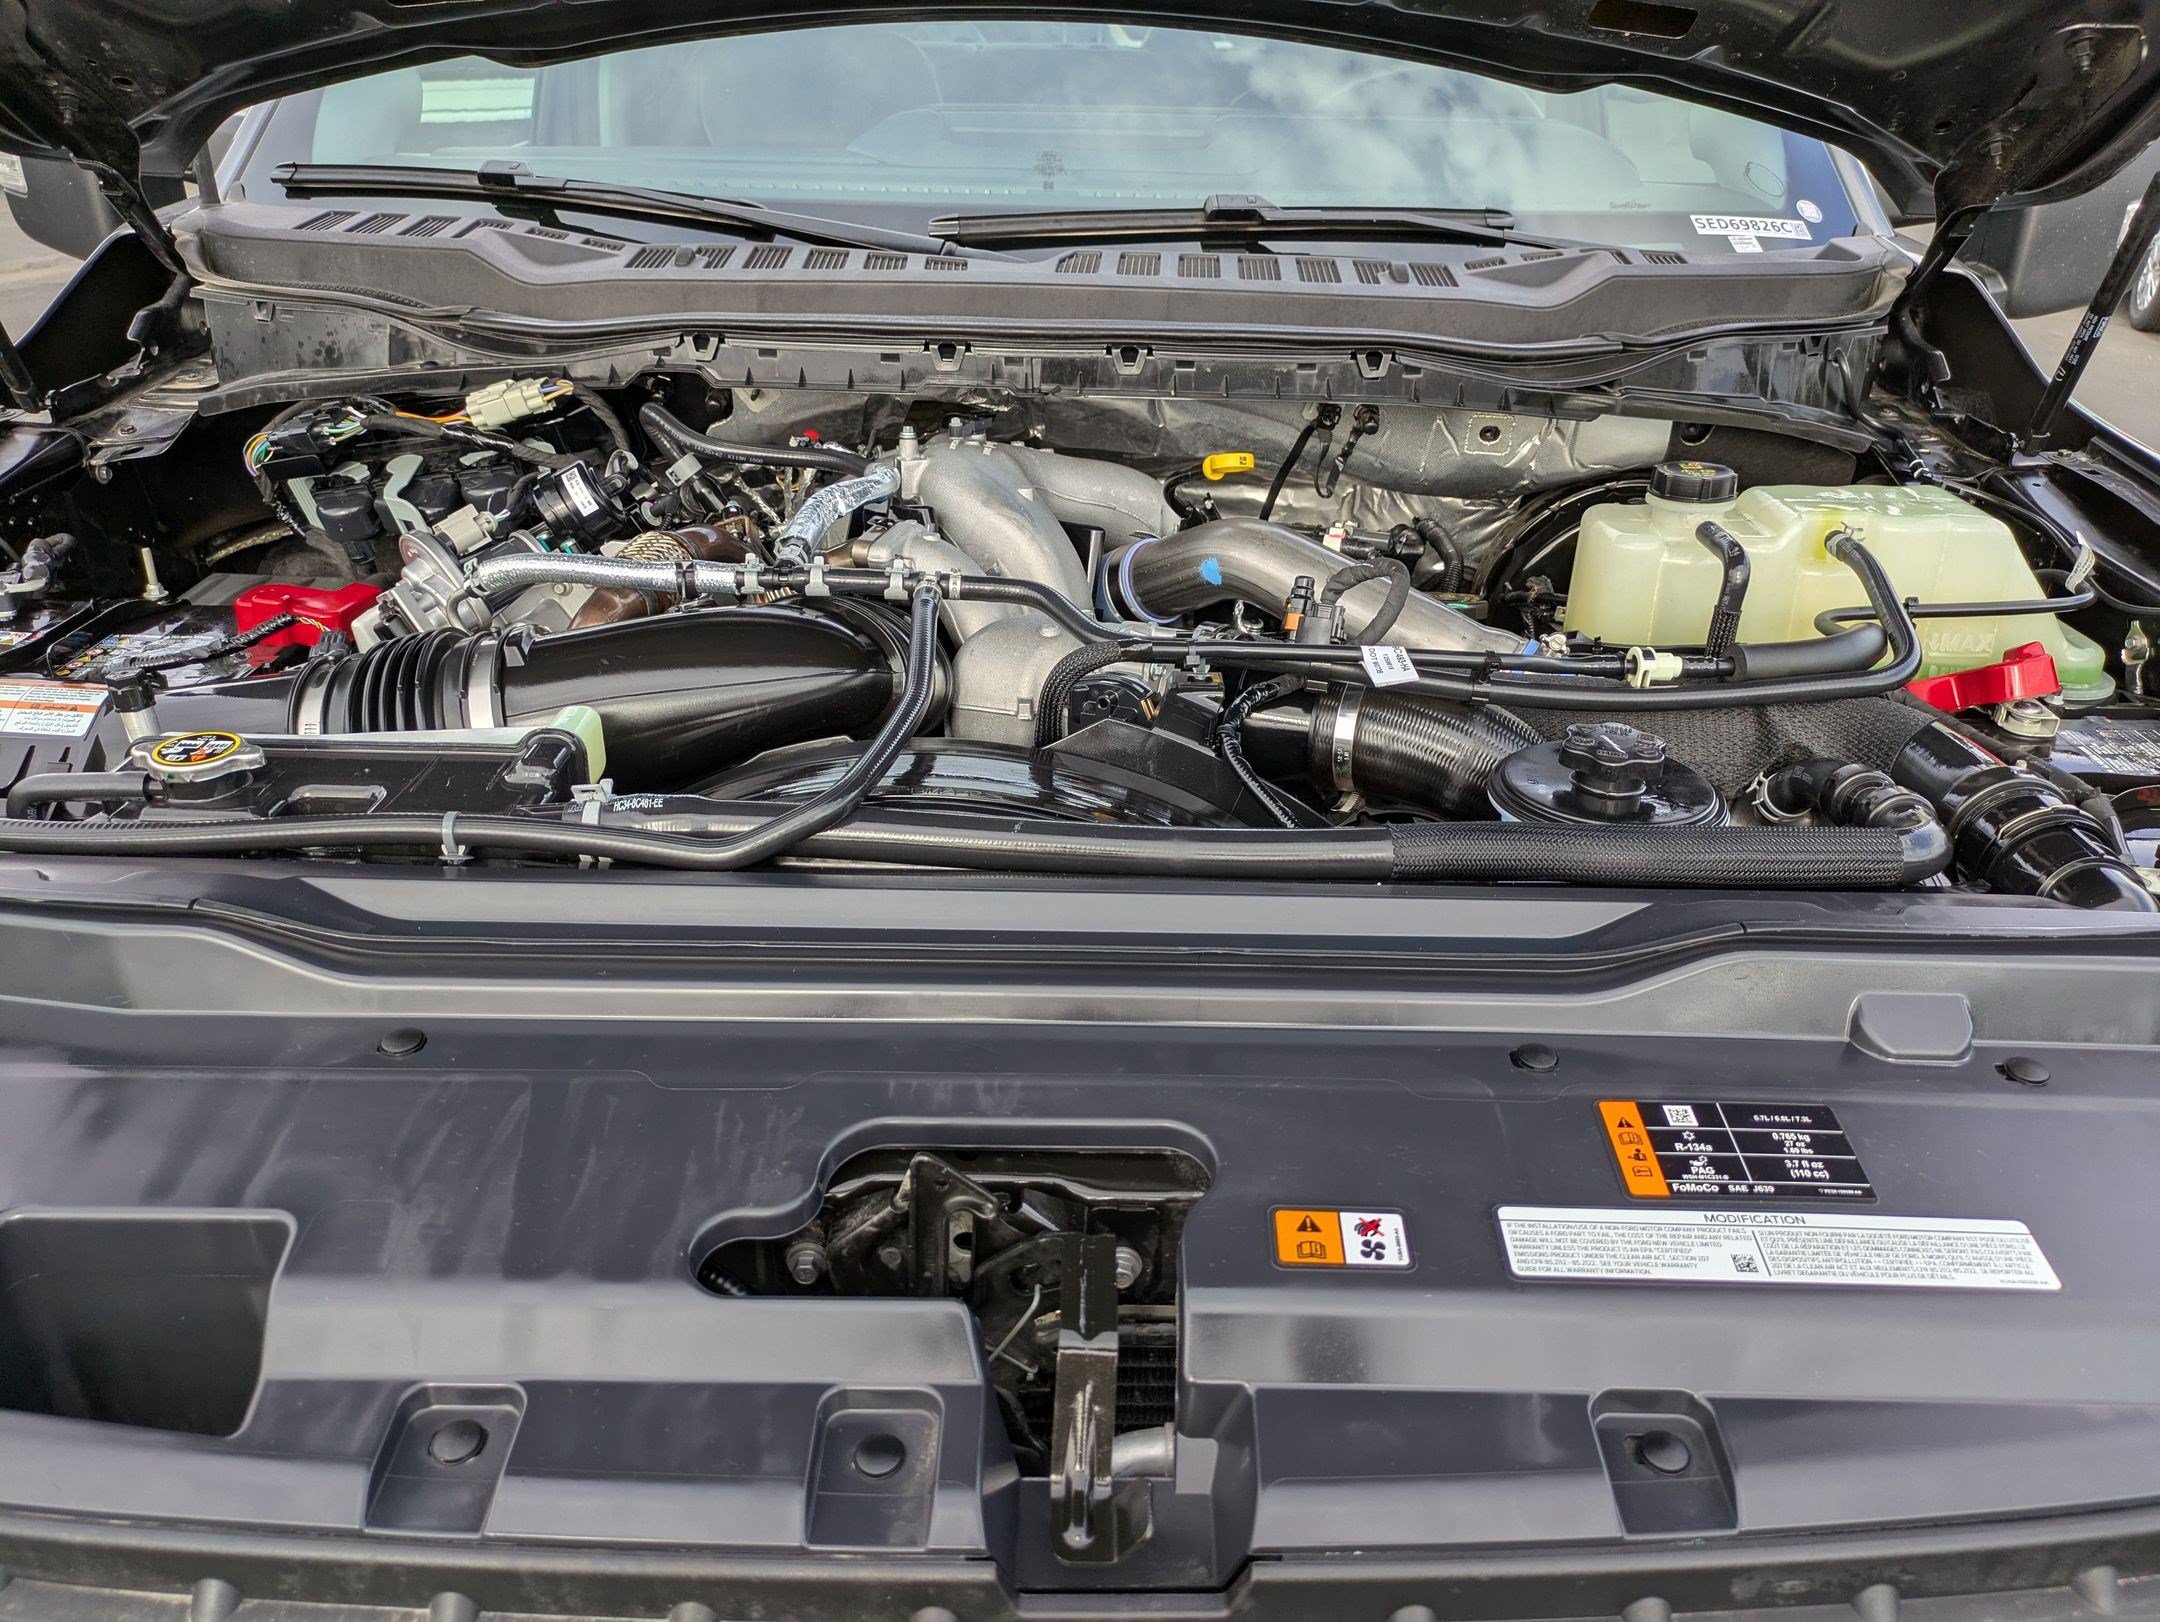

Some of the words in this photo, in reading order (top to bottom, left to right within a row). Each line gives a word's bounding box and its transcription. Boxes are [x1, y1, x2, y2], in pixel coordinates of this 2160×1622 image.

[1694, 217, 1792, 234] SED69826C
[1797, 1134, 1811, 1143] kg
[1675, 1143, 1713, 1152] R-134a
[1784, 1160, 1799, 1168] 3.7
[1801, 1160, 1810, 1168] fl
[1811, 1161, 1825, 1169] oz
[1691, 1167, 1715, 1175] PAG
[1790, 1169, 1812, 1179] (110
[1812, 1170, 1830, 1180] cc)
[1672, 1183, 1720, 1192] FoMoCo
[1728, 1185, 1749, 1193] SAE
[1702, 1213, 1806, 1224] MODIFICATION
